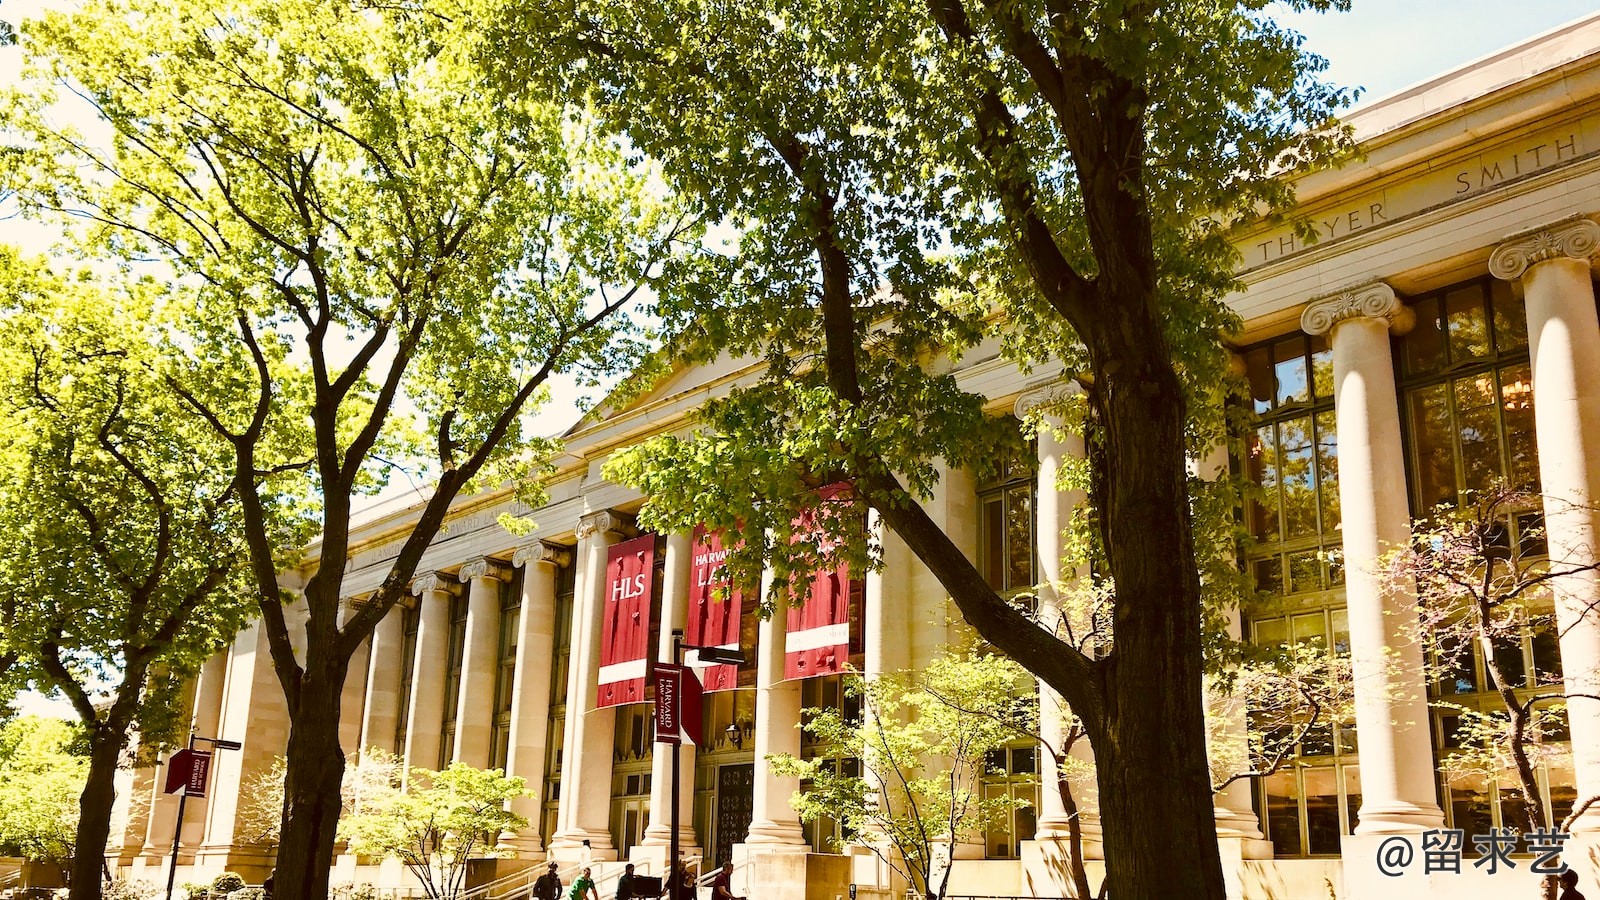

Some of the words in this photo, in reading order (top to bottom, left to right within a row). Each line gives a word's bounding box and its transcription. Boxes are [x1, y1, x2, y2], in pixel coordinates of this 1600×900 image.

[1257, 203, 1387, 260] THYER
[1456, 135, 1577, 194] SMITH
[373, 541, 403, 562] LANGD
[695, 548, 734, 566] HARVA
[611, 573, 645, 601] HLS
[697, 564, 730, 587] LA
[664, 679, 673, 728] HARVARD
[191, 759, 200, 789] HARVARD
